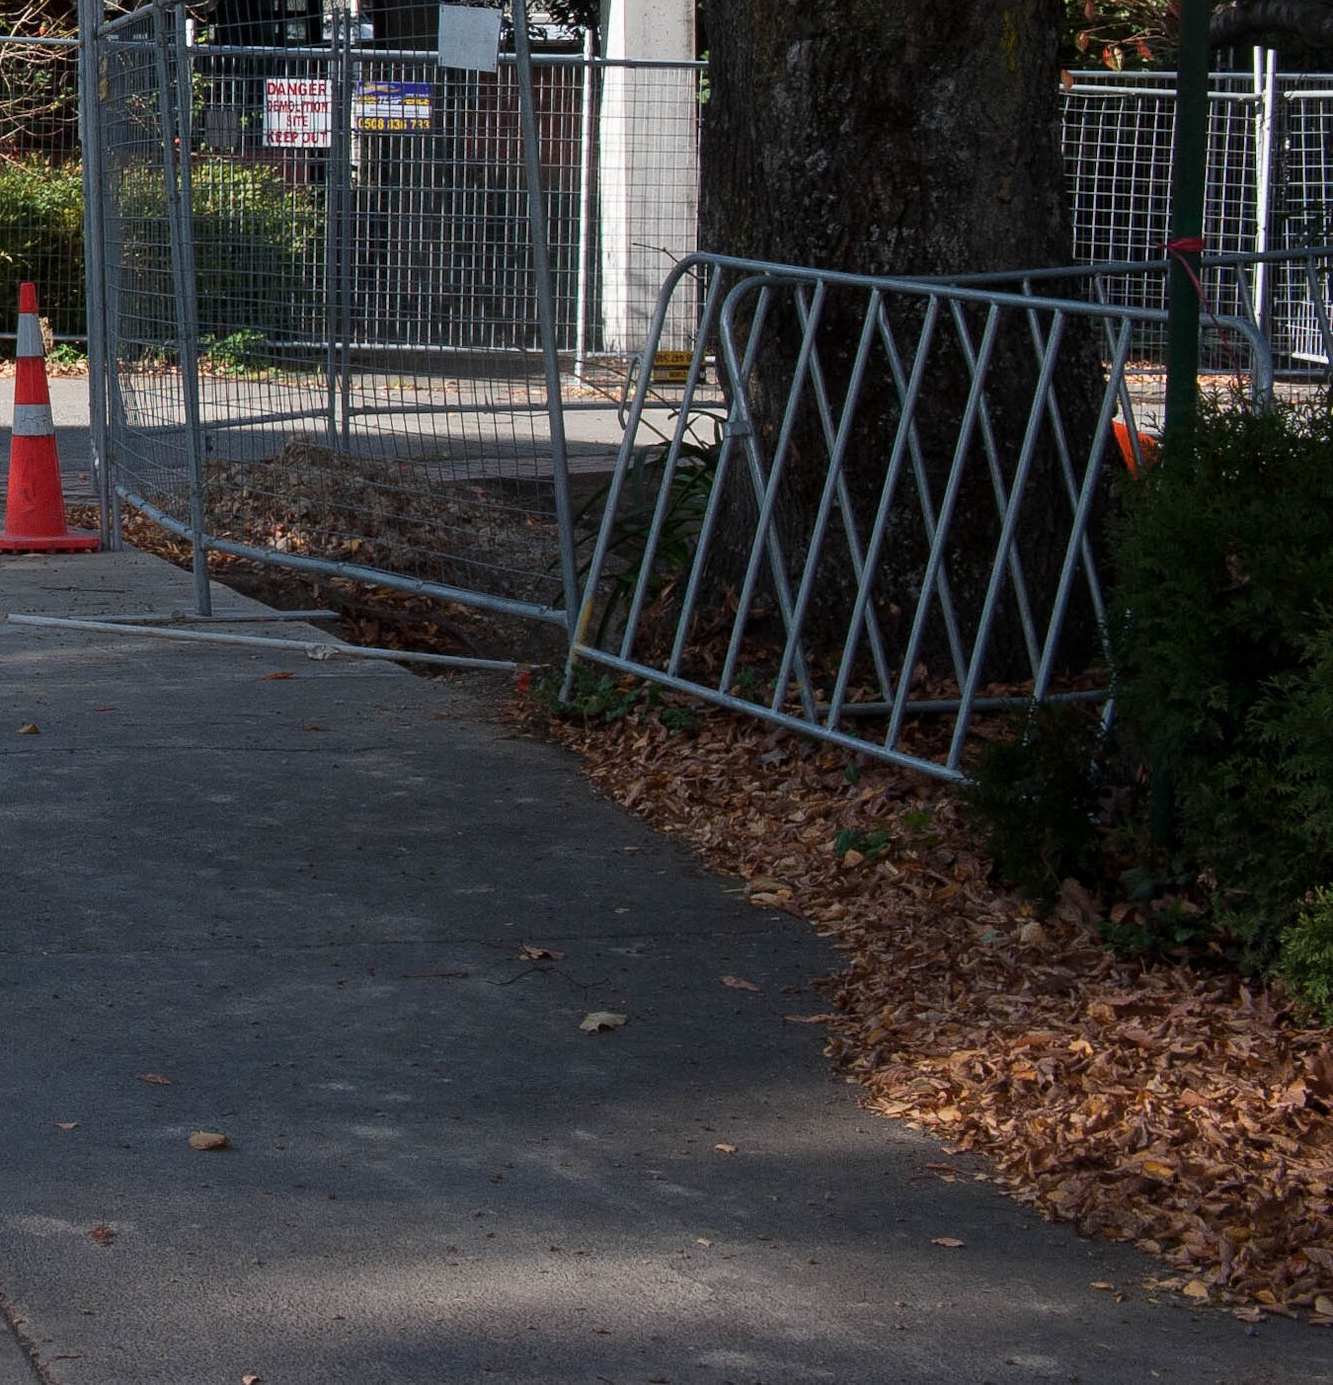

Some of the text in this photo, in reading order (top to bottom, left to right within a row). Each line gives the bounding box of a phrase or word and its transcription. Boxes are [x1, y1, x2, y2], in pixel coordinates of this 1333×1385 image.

[267, 82, 326, 96] DANGER
[267, 100, 328, 113] DEMOLITION
[286, 115, 308, 127] SITE
[266, 130, 327, 144] KEEP OUT
